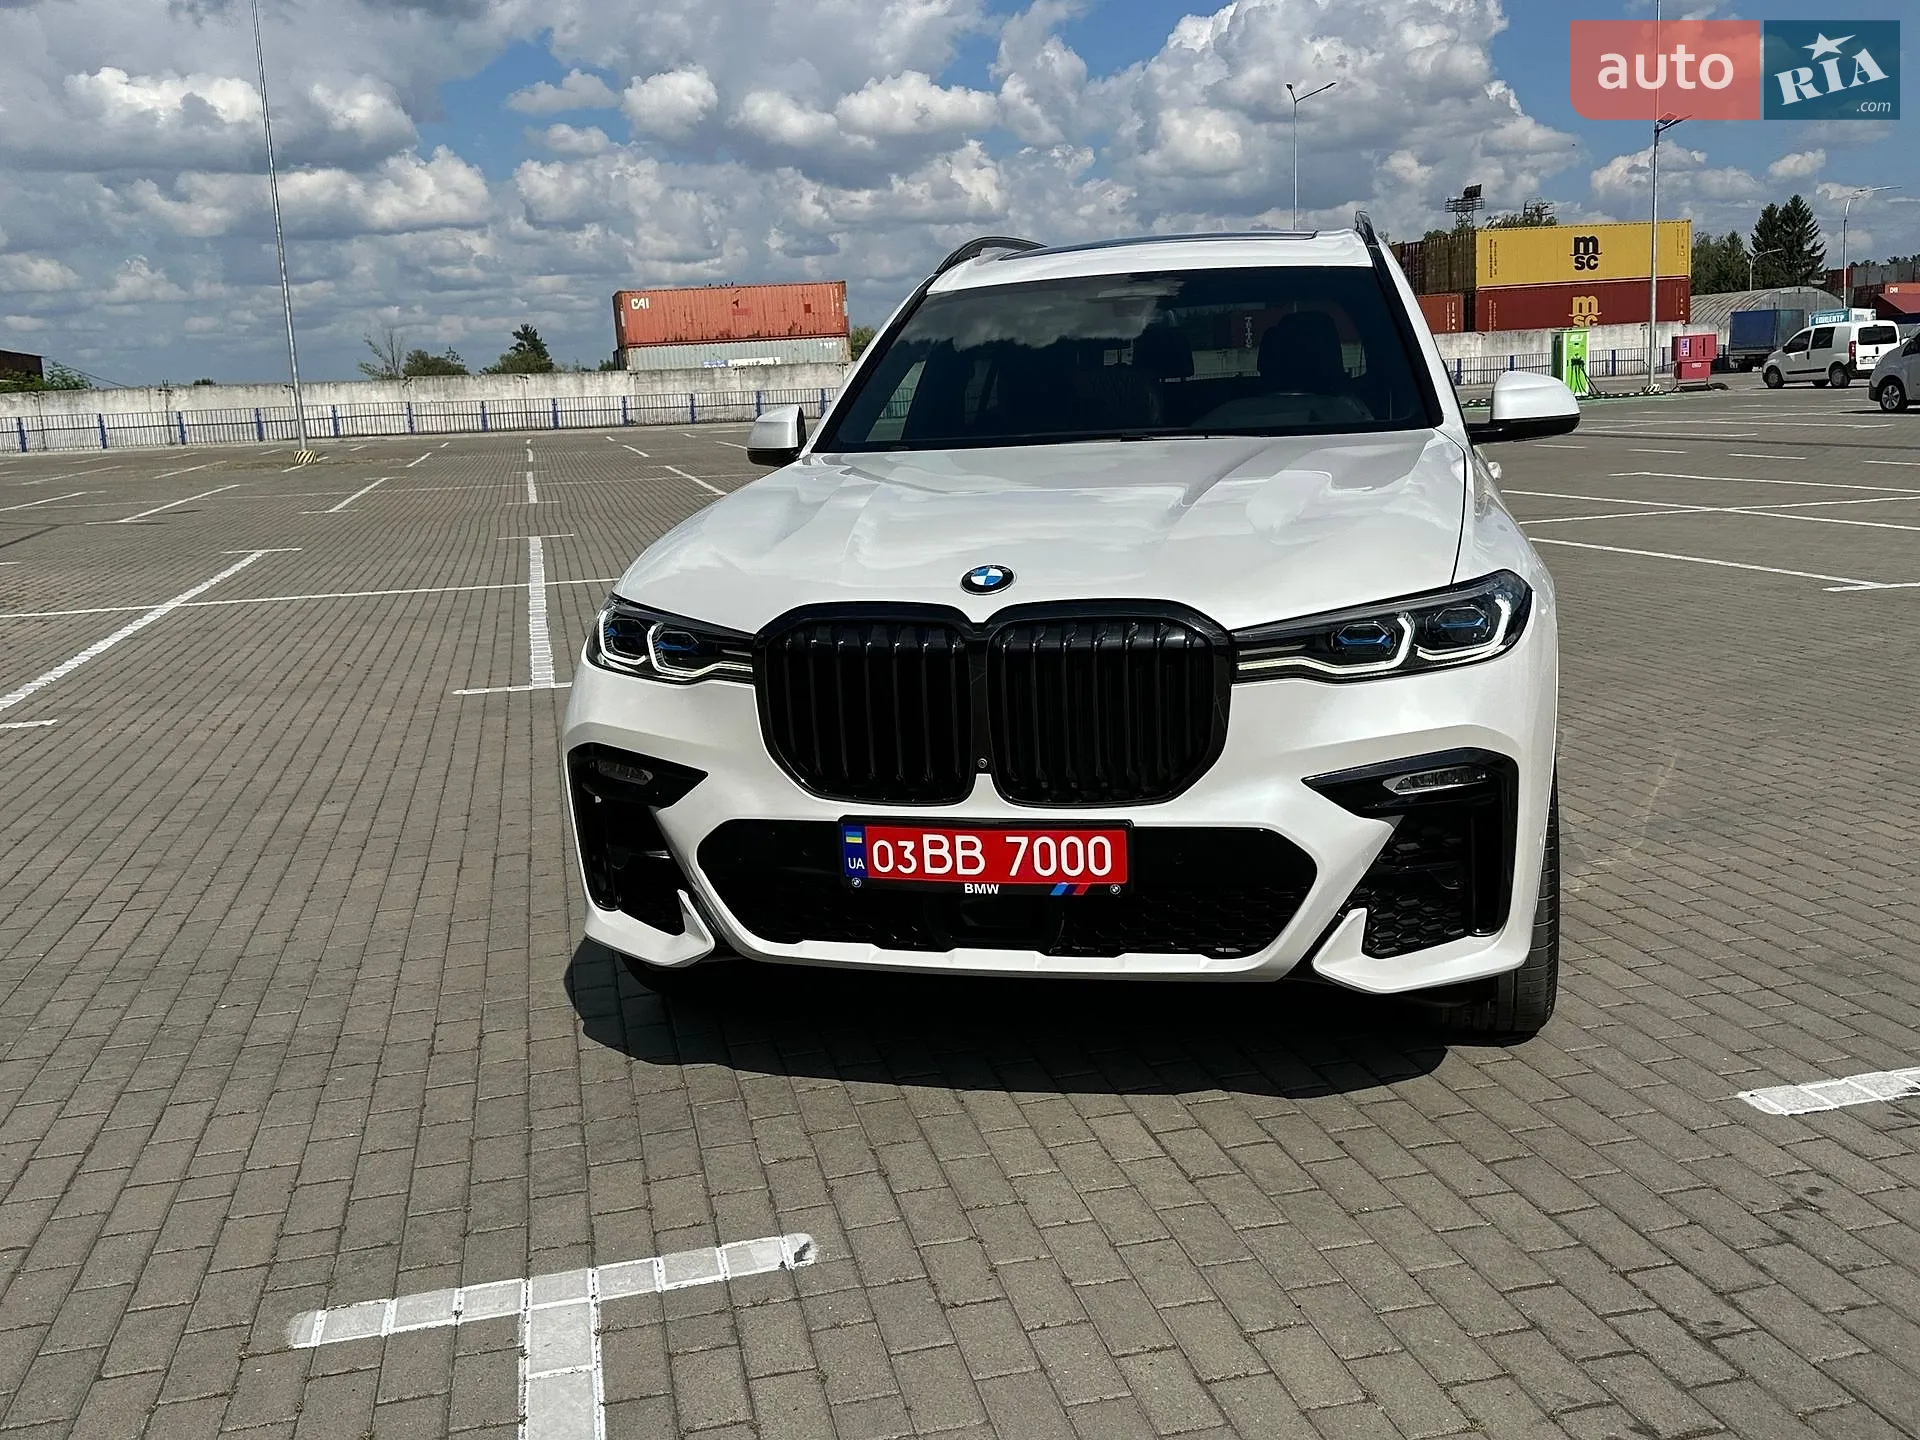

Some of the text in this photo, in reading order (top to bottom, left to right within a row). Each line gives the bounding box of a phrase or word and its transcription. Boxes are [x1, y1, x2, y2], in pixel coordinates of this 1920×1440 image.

[631, 298, 650, 310] CAI
[1005, 836, 1113, 878] 7000
[848, 857, 866, 870] UA
[964, 883, 1000, 895] BMW
